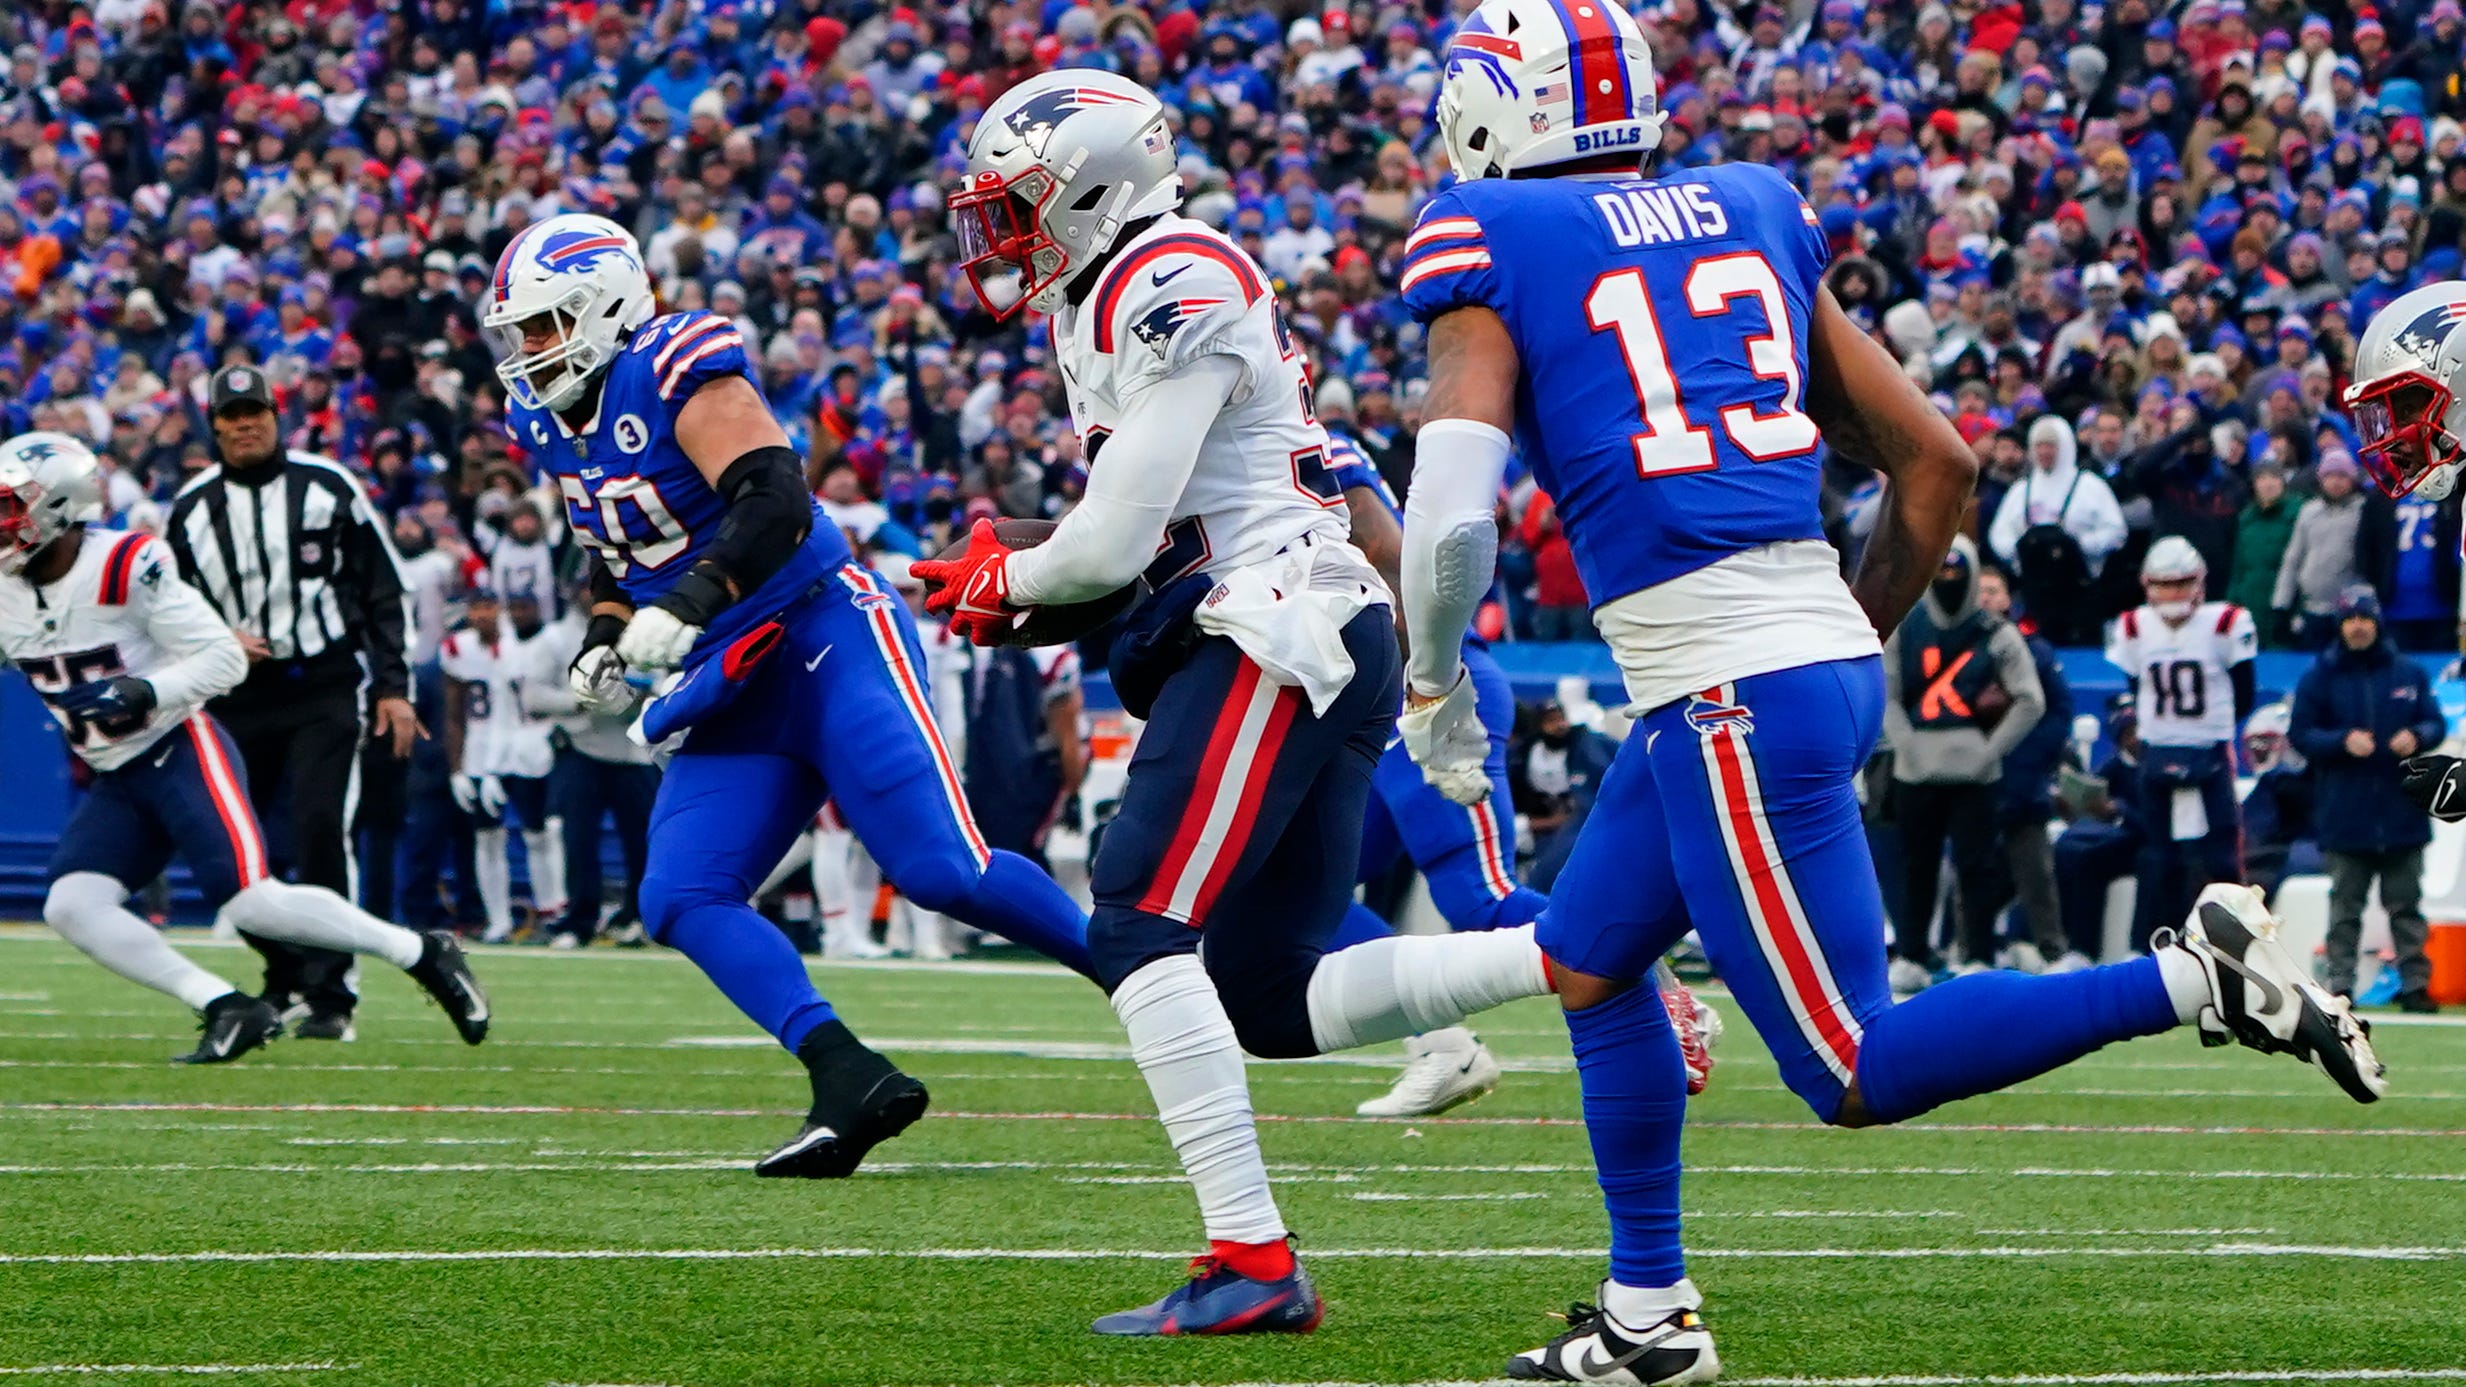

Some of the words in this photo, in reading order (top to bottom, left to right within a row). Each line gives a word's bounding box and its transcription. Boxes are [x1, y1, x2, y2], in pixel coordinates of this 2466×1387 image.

[1573, 127, 1641, 153] BILLS
[1593, 183, 1729, 247] DAVIS
[1583, 250, 1821, 479] 13
[620, 419, 642, 450] 3
[2148, 660, 2206, 717] 10
